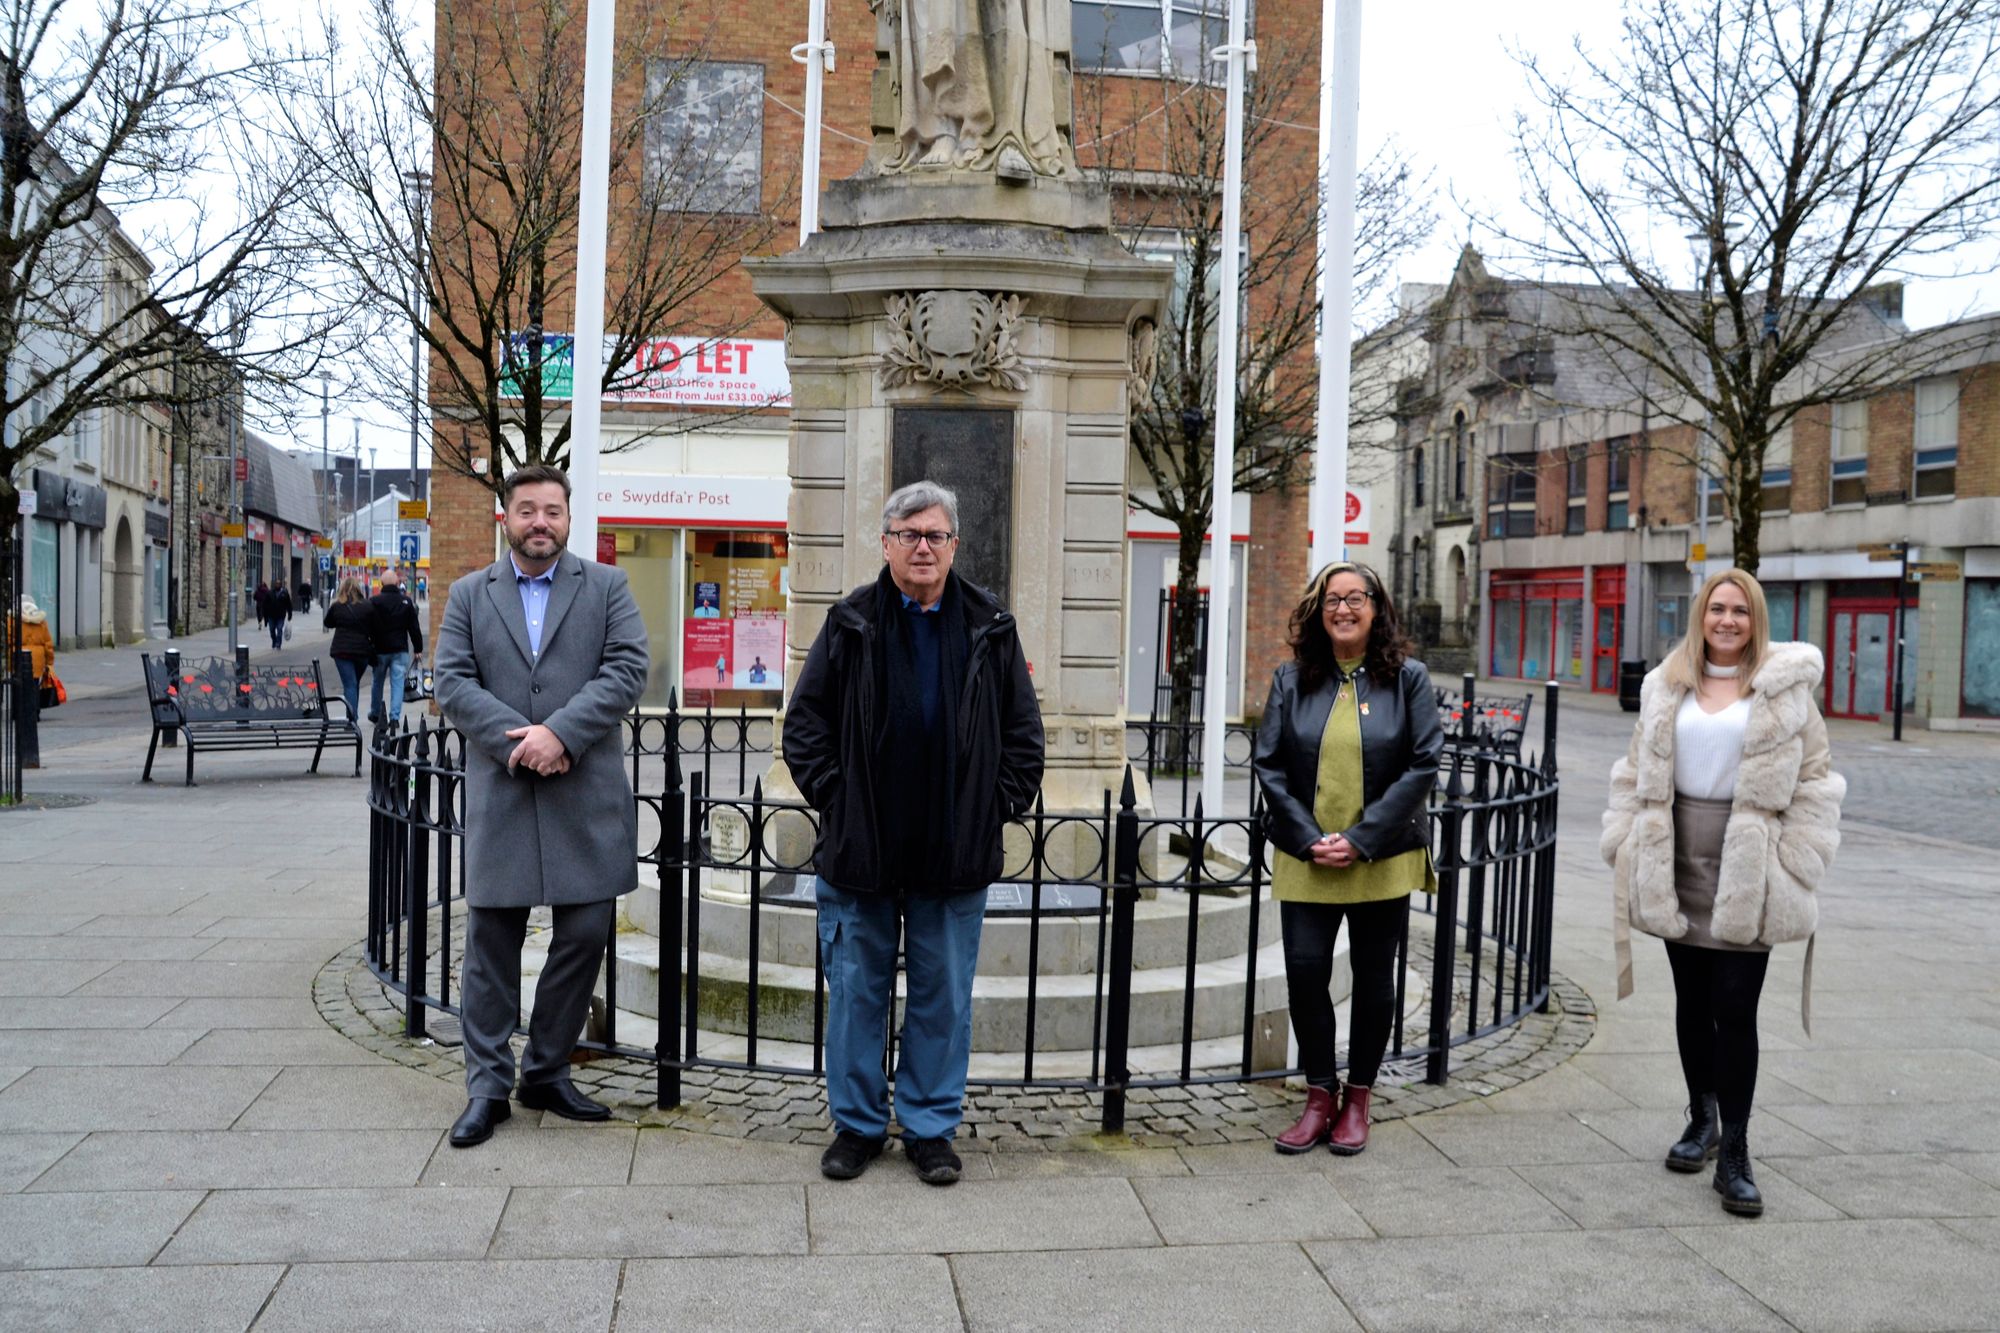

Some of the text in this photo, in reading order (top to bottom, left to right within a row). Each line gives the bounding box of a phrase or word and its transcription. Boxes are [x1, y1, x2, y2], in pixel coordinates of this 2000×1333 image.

[634, 341, 754, 374] TO LET
[719, 380, 757, 390] Space
[649, 390, 672, 399] Rent
[676, 391, 700, 401] From
[704, 392, 725, 401] Just
[623, 489, 694, 506] Swyddfa'r
[698, 491, 731, 505] Post
[797, 561, 836, 577] 1914
[1073, 567, 1113, 584] 1918
